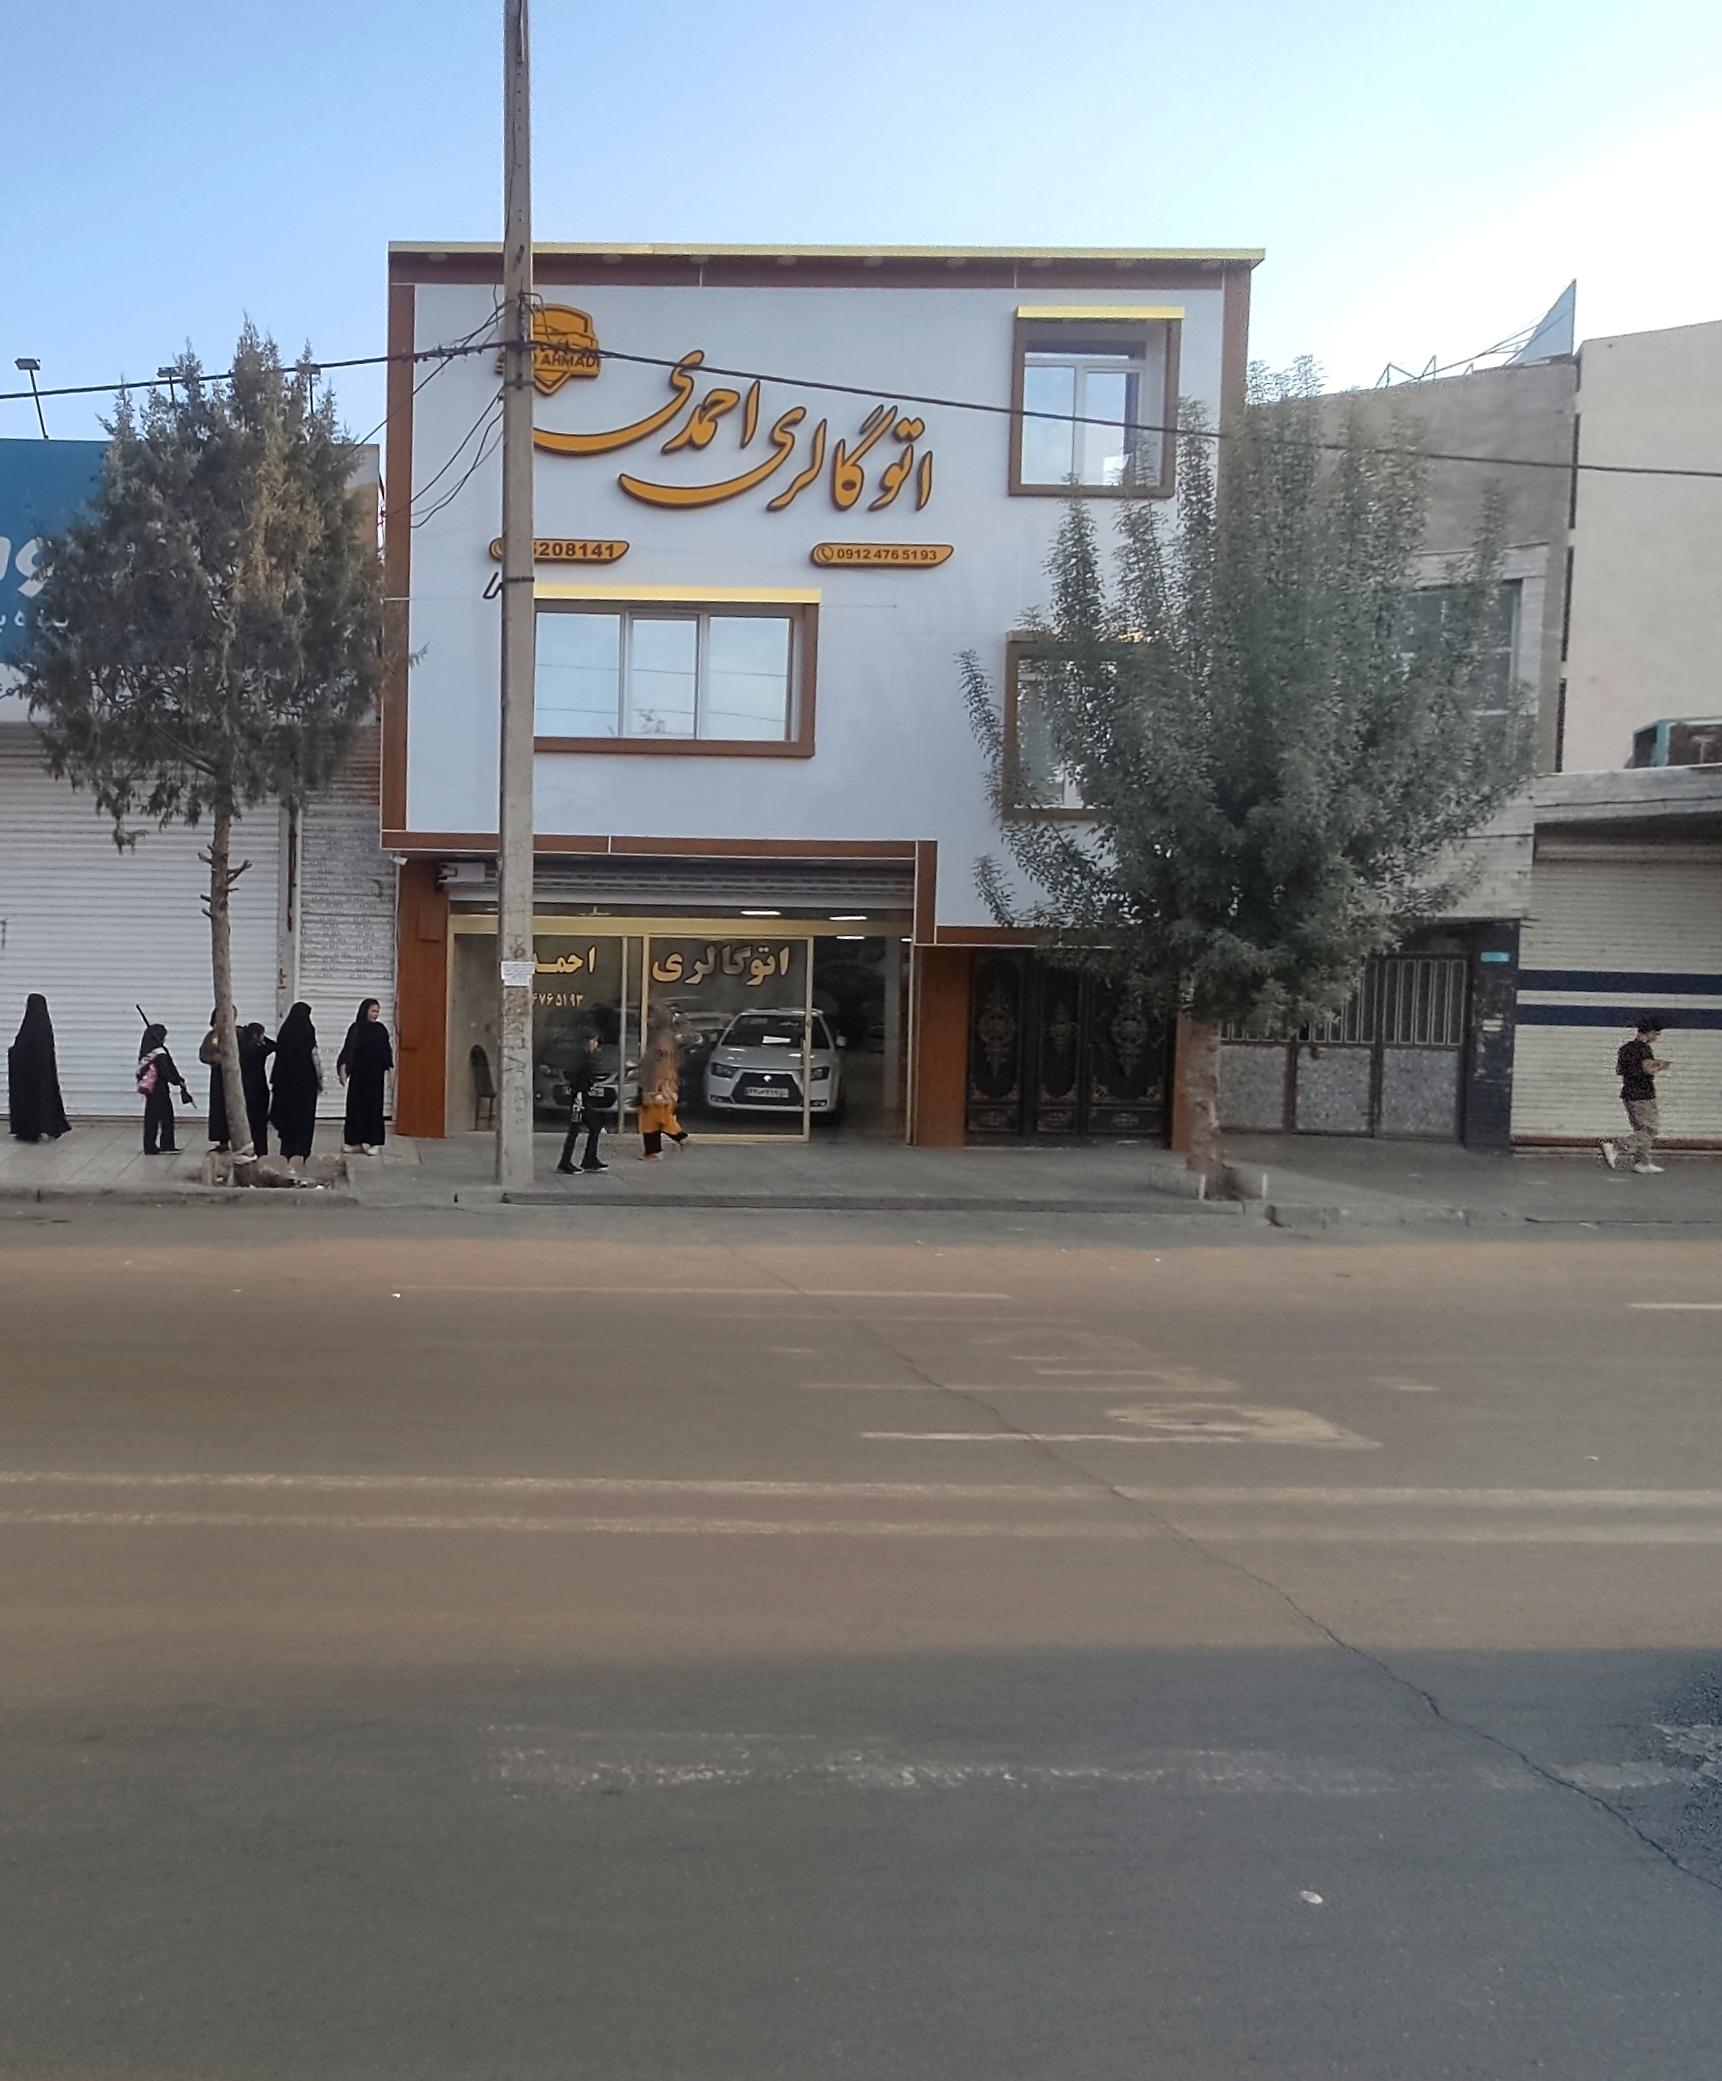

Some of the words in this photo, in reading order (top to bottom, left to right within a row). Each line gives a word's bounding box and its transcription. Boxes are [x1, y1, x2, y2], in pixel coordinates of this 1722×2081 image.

[540, 351, 600, 369] AHMADI
[532, 349, 761, 456] احمدی
[534, 542, 615, 557] 208141
[837, 548, 871, 560] 0912
[873, 549, 900, 560] 476
